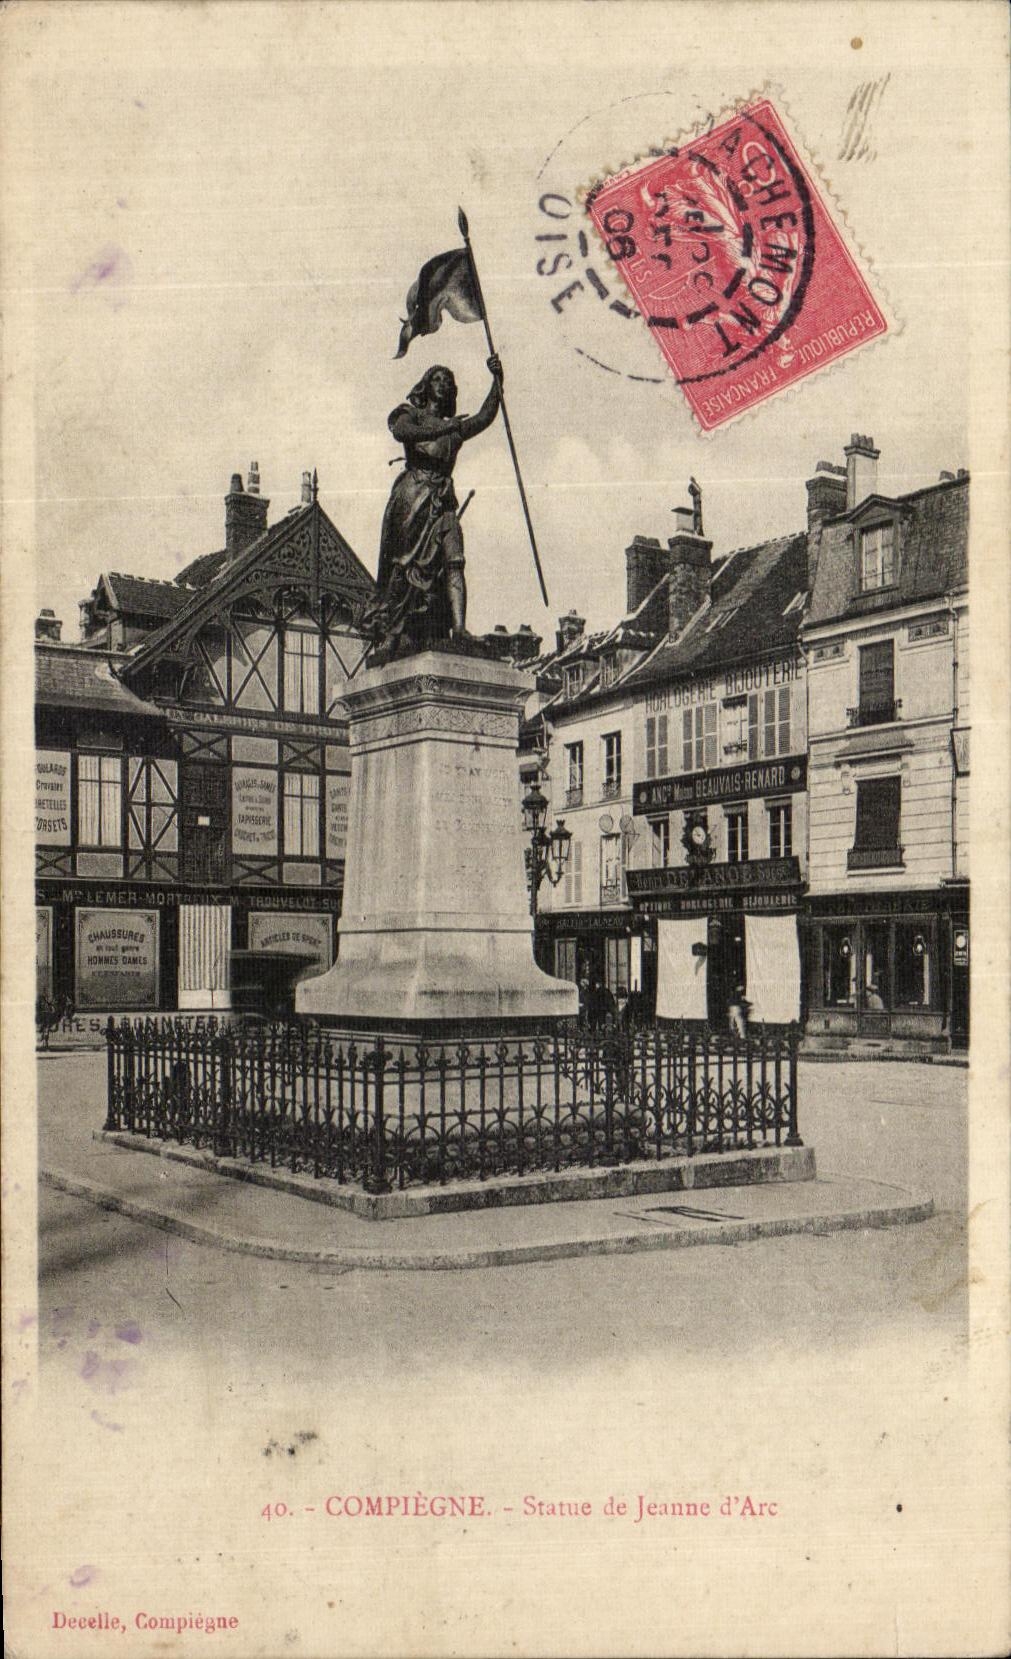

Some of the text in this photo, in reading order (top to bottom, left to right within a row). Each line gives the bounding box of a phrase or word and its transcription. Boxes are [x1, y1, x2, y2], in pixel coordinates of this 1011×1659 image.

[534, 193, 584, 314] OISE
[696, 113, 798, 358] ACHEMONT
[645, 657, 803, 713] HORLOGERIE BIJOUTERIE
[695, 765, 786, 798] BEAUVAIS-RENARD
[88, 928, 145, 944] CHAUSSURES
[87, 955, 148, 966] HOMMES DAMES
